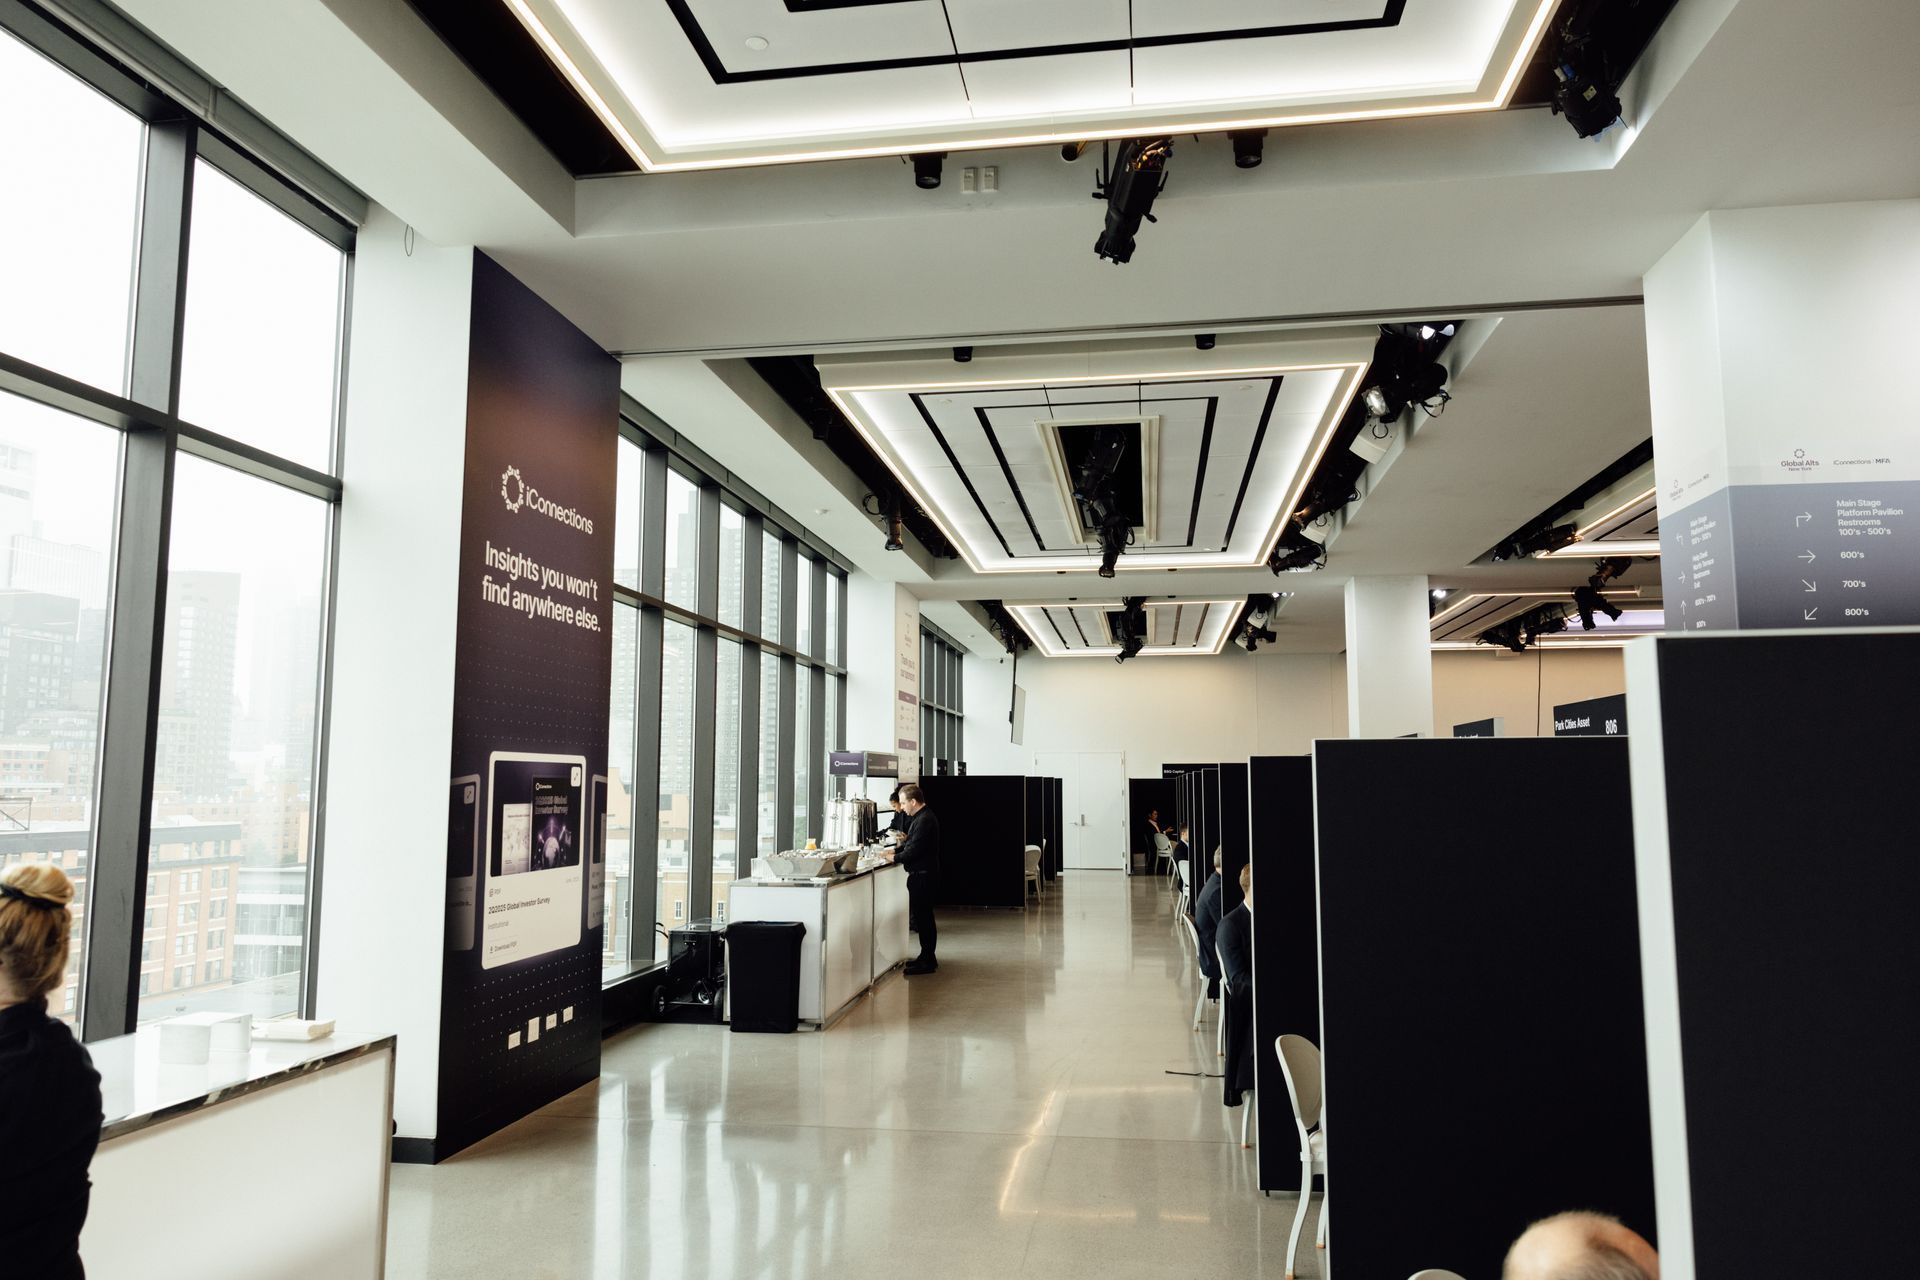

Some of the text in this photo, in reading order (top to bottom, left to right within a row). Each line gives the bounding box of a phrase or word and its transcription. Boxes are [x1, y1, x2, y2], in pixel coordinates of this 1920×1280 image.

[526, 486, 593, 534] iConnections
[1857, 500, 1881, 508] Stage
[1837, 507, 1904, 517] Platform Pavilion
[1839, 528, 1861, 536] 100's
[1867, 527, 1891, 535] 500's
[1840, 551, 1865, 559] 600's
[485, 540, 598, 601] Insights you won't
[1842, 580, 1867, 588] 700's
[482, 574, 601, 632] find anywhere else.
[1845, 607, 1869, 616] 800's
[1555, 717, 1590, 731] Park Cities Asset
[1605, 719, 1618, 734] 806
[488, 903, 507, 915] 2Q2025
[506, 902, 520, 911] Global
[520, 899, 536, 908] Investor
